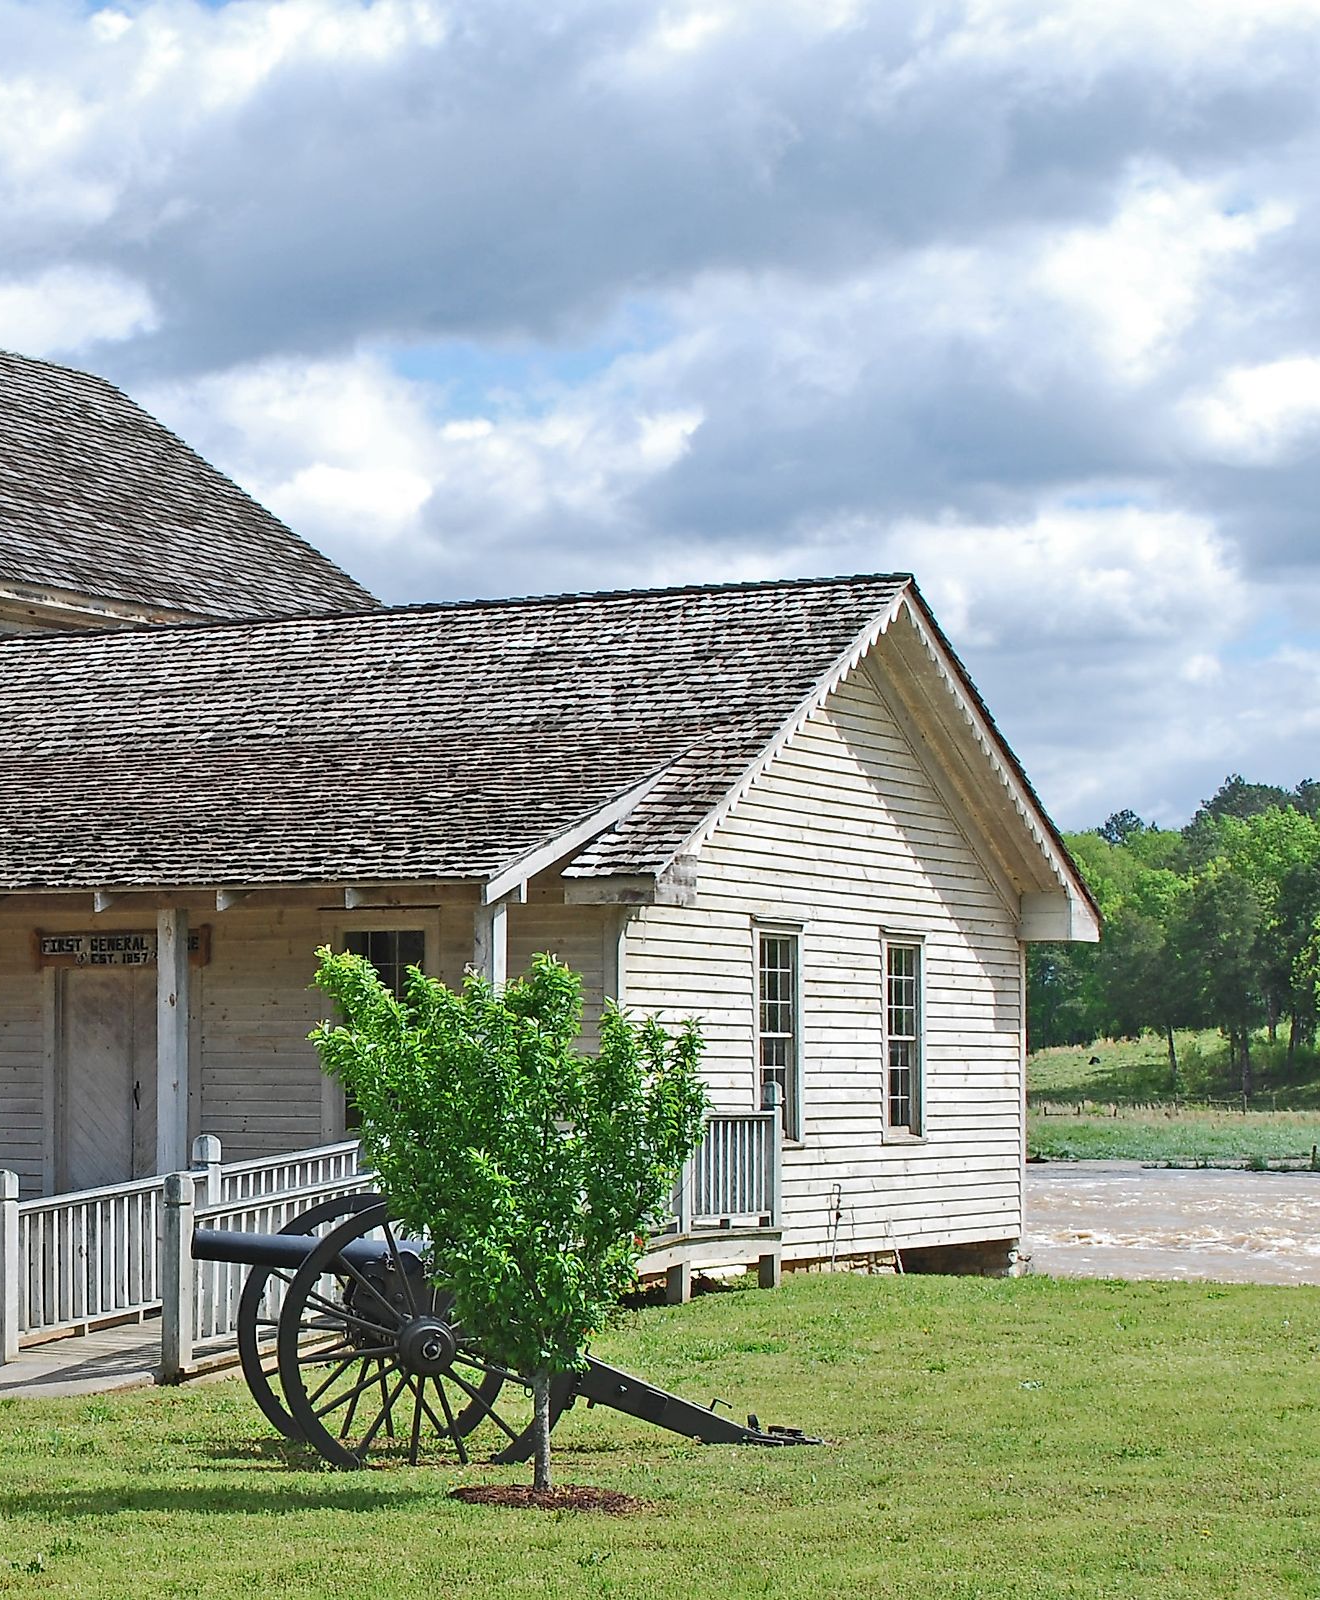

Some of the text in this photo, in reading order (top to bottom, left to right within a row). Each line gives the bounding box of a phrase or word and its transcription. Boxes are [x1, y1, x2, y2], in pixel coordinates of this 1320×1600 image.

[42, 937, 149, 952] FIRST GENERAL
[90, 952, 148, 964] EST. 1857
